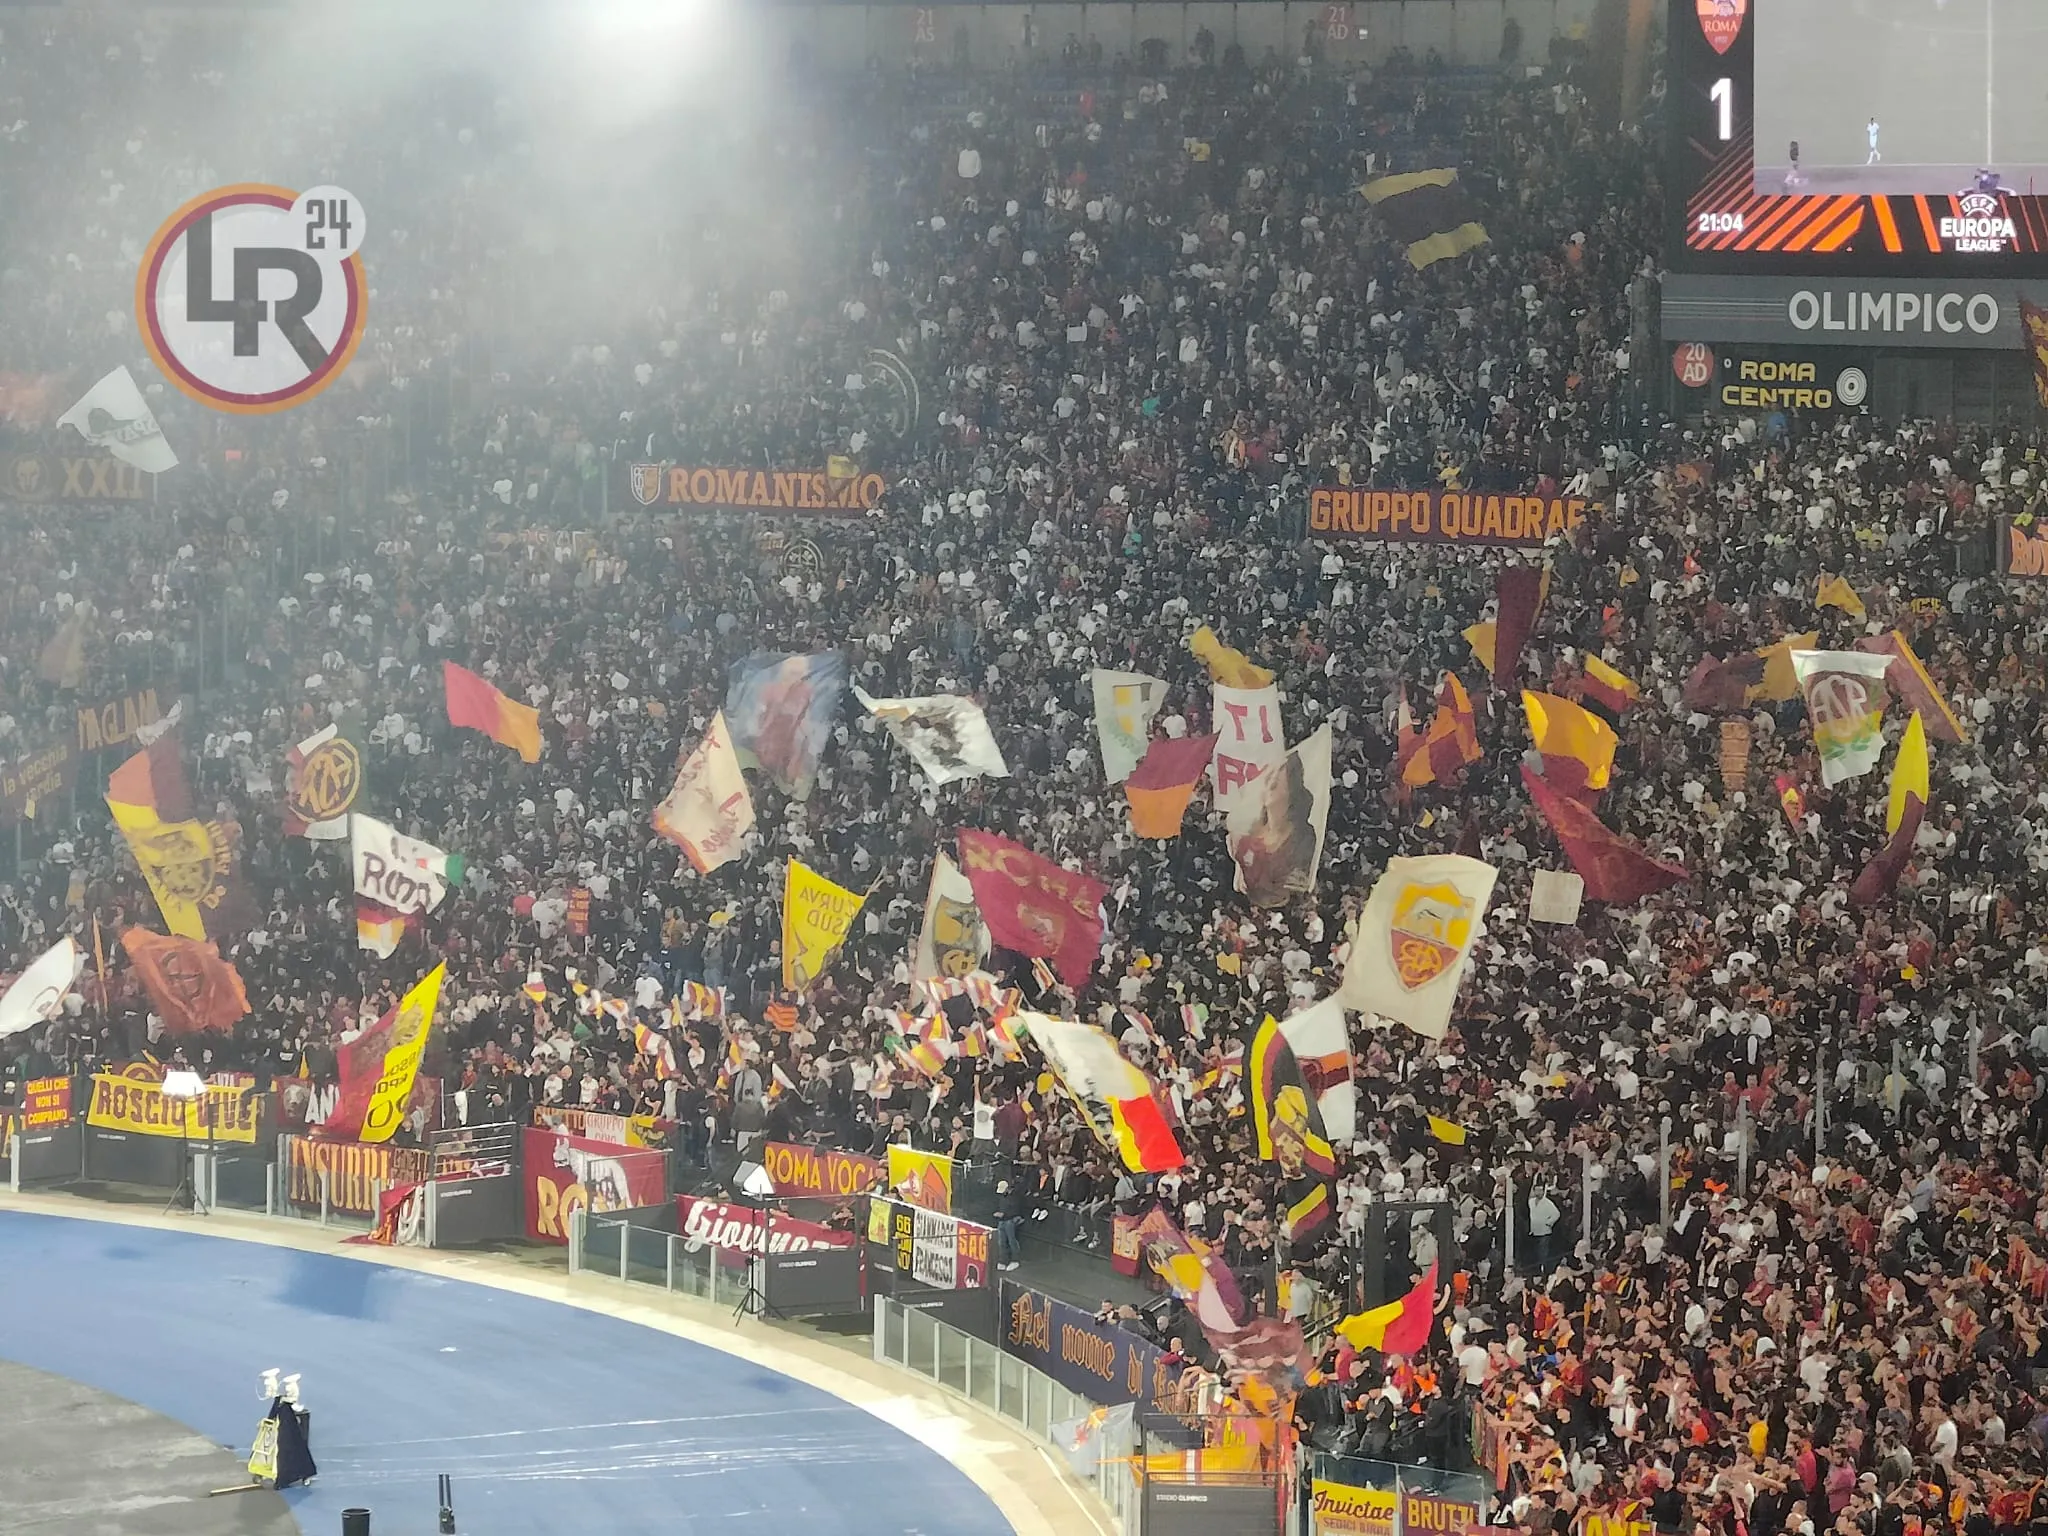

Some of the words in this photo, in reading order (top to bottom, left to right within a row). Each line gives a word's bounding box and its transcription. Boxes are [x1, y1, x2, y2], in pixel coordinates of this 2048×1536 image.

[1328, 6, 1346, 24] 21
[1326, 25, 1348, 41] AD
[1704, 20, 1738, 33] ROMA
[1710, 78, 1733, 141] 1
[1960, 196, 1998, 215] UEFA
[1698, 212, 1744, 233] 21:04
[1940, 217, 2017, 239] EUROPA
[1955, 239, 2001, 252] LEAGUE
[1788, 290, 2000, 334] OLIMPICO
[1685, 343, 1706, 361] 20
[1682, 363, 1708, 382] AD
[1739, 360, 1816, 382] ROMA
[1722, 385, 1833, 409] CENTRO
[1310, 489, 1431, 534] GRUPPO
[1439, 493, 1602, 541] QUADRA
[764, 1146, 822, 1191] ROMA
[1008, 1292, 1052, 1353] Nel
[1061, 1322, 1116, 1382] nome
[1127, 1343, 1145, 1399] di
[1313, 1489, 1394, 1521] Invictae
